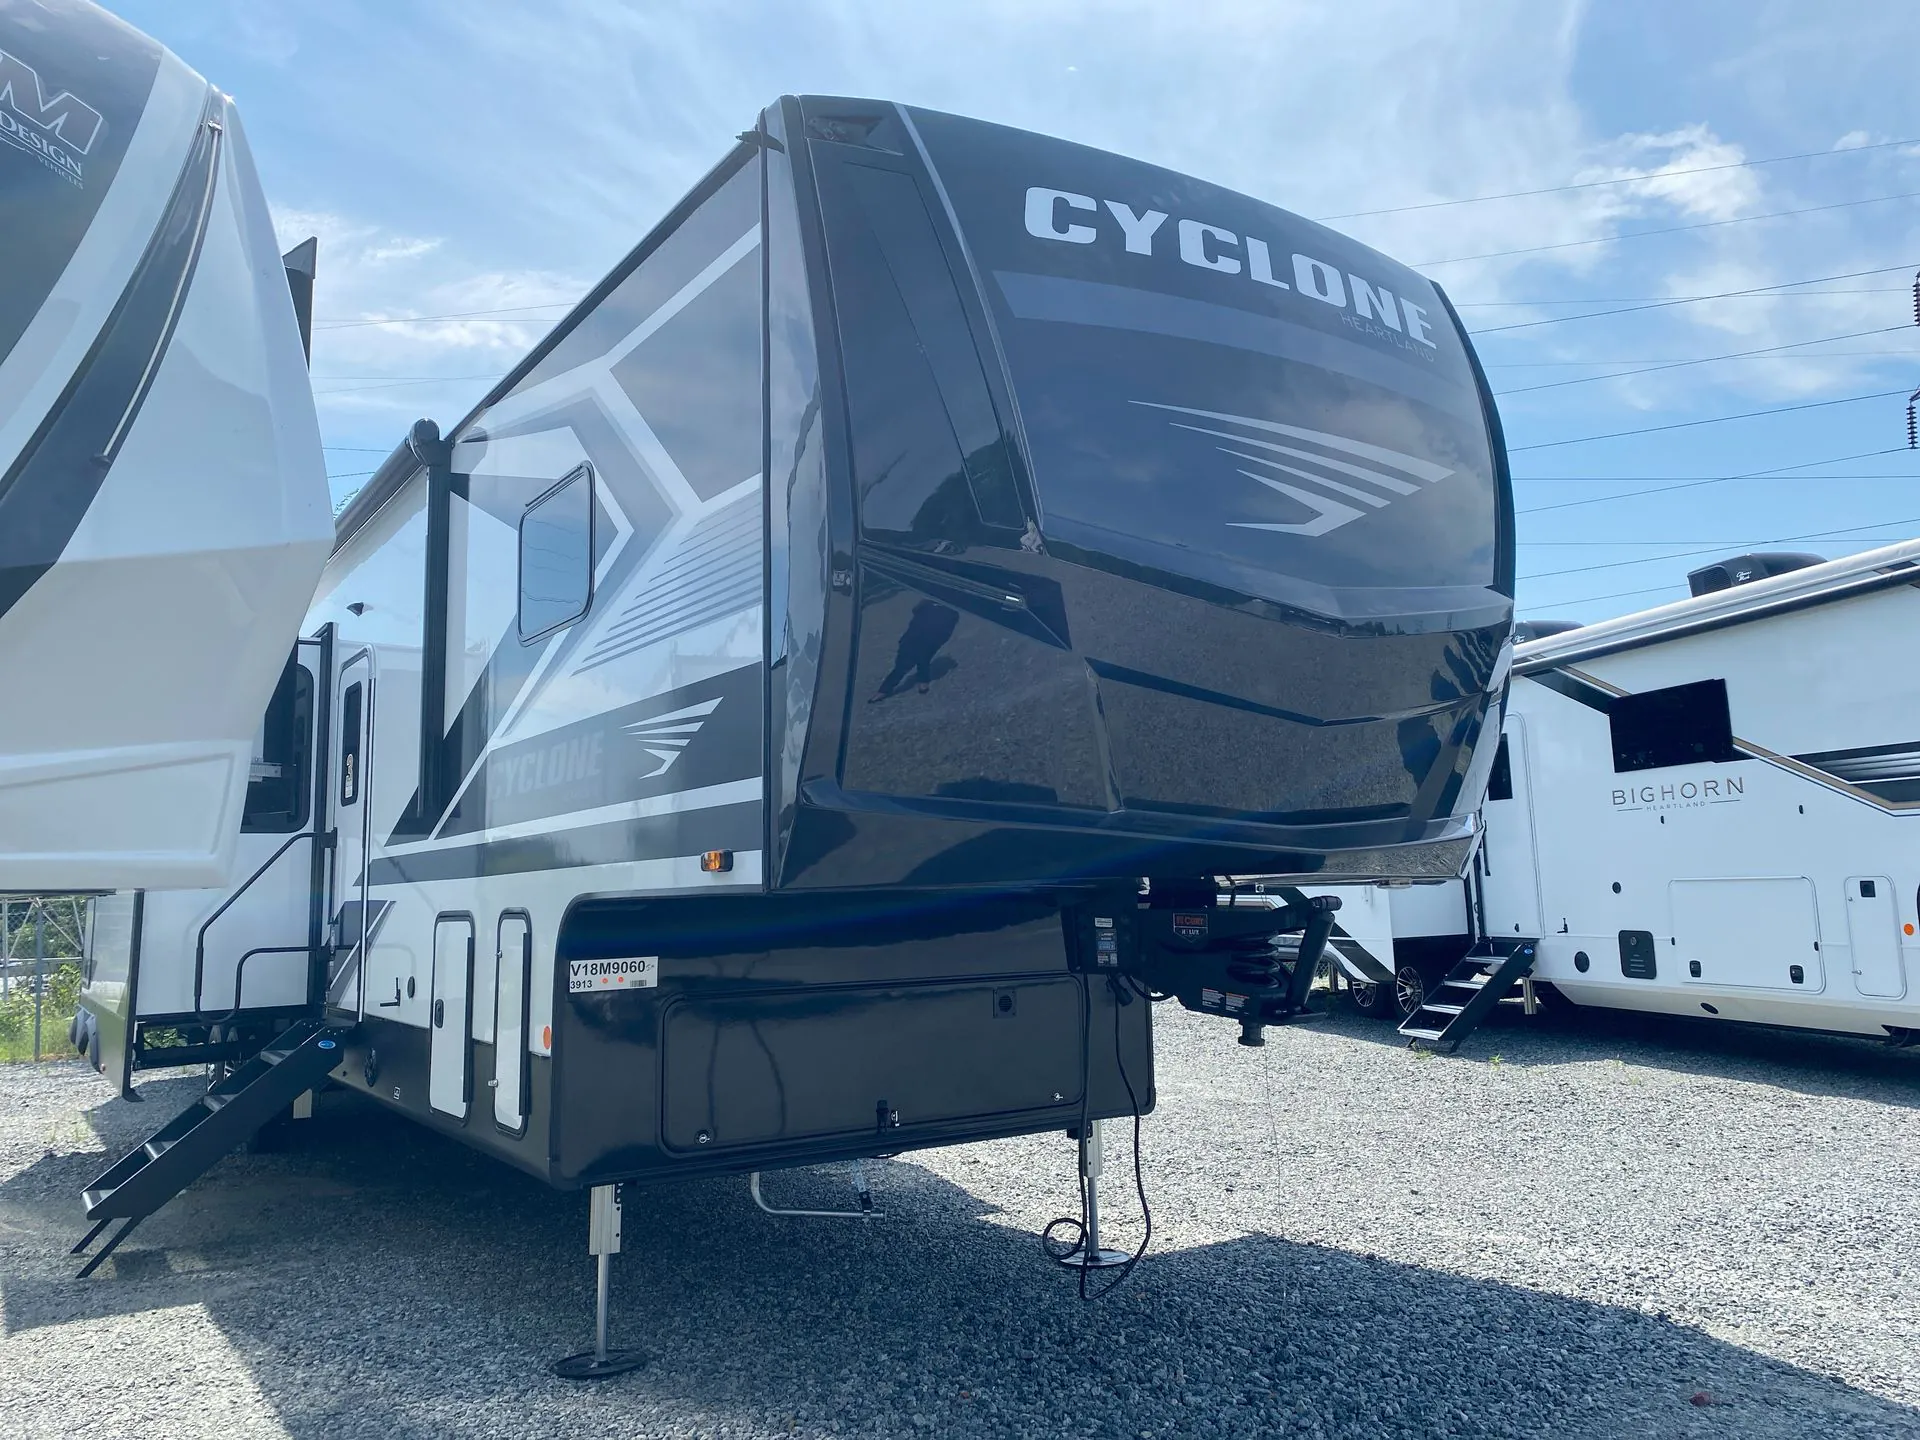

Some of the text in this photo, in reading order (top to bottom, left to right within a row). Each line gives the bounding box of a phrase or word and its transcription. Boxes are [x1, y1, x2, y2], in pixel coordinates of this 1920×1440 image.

[0, 110, 83, 176] DESIGN
[1024, 186, 1437, 350] CYCLONE
[1340, 311, 1435, 364] HEARTLAND
[492, 732, 605, 800] CYCLONE
[1612, 777, 1744, 806] BIGHORN
[1646, 801, 1706, 812] HEARTLAND
[570, 961, 646, 977] V18M9060
[570, 980, 593, 990] 3913
